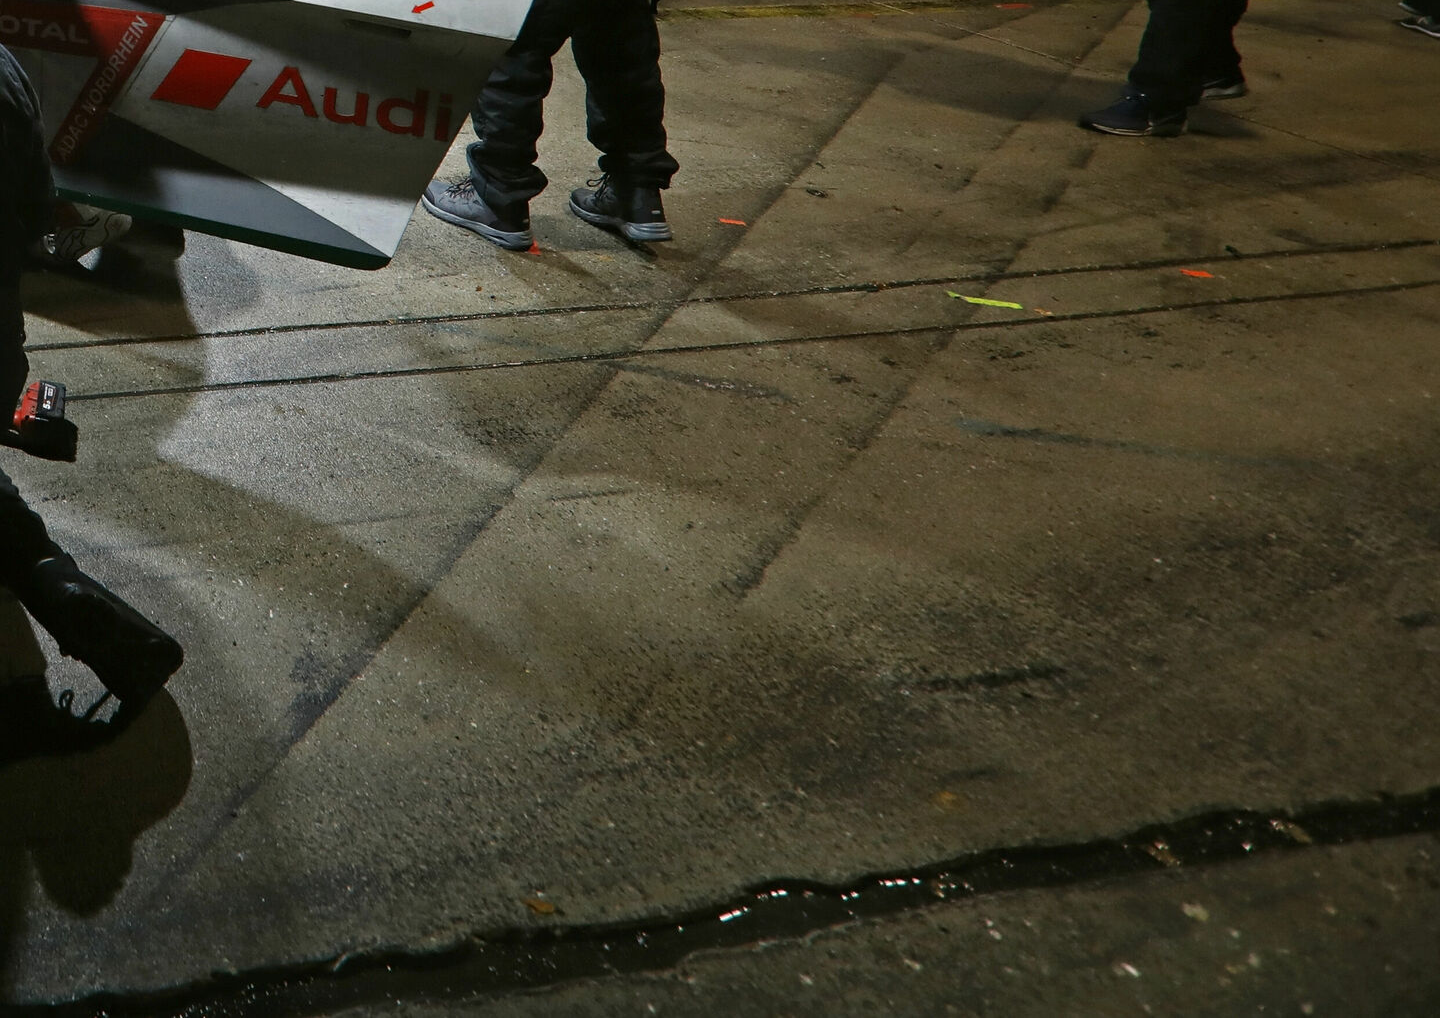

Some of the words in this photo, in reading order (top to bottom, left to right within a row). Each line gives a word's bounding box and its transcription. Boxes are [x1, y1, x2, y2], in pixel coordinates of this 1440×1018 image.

[59, 114, 89, 162] ADAC
[83, 15, 149, 120] NORDRHEIN
[256, 66, 455, 143] Audi
